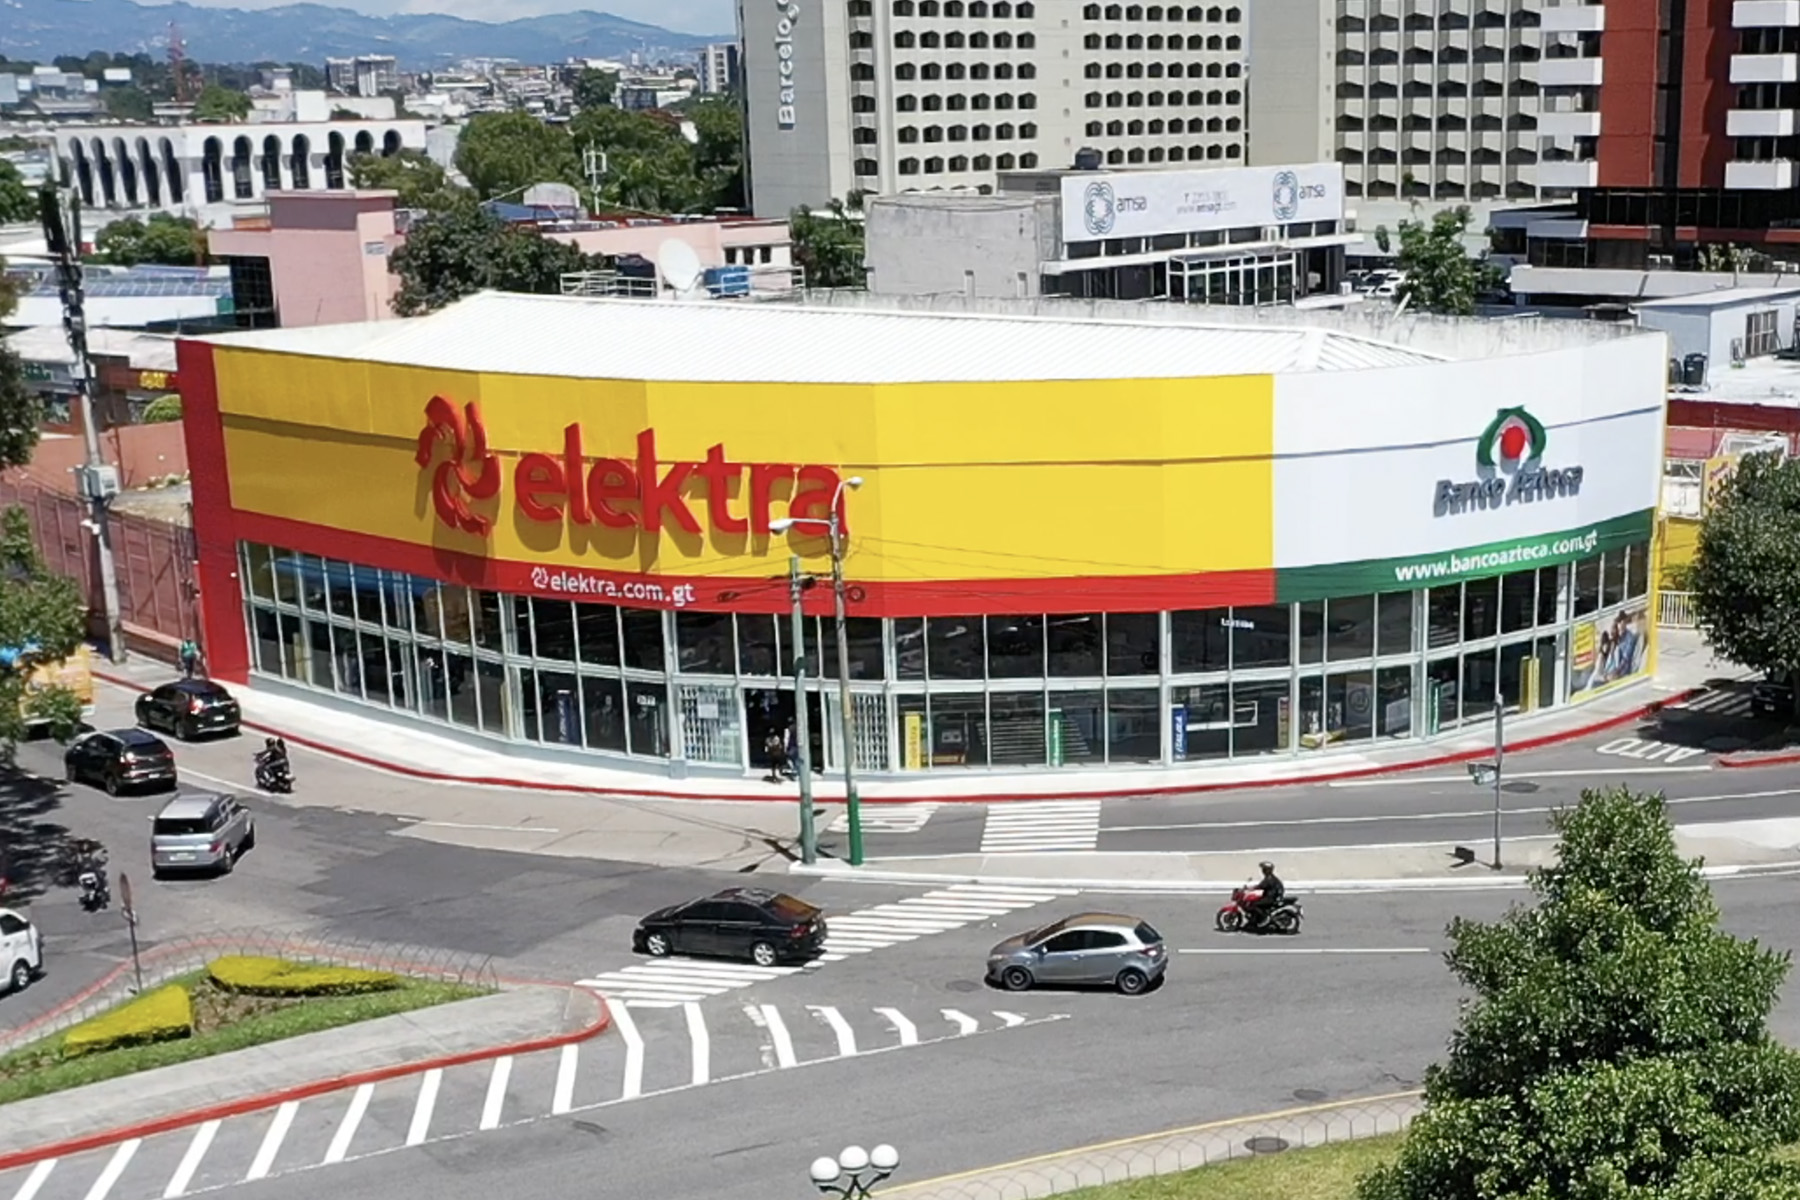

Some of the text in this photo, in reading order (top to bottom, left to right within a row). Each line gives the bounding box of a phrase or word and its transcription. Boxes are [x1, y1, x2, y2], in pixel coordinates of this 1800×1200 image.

[514, 421, 848, 536] elektra
[1434, 465, 1584, 512] Banco Azteca
[1394, 529, 1599, 582] www.bancoazteca.com.gt
[550, 571, 696, 607] elektra.com.gt
